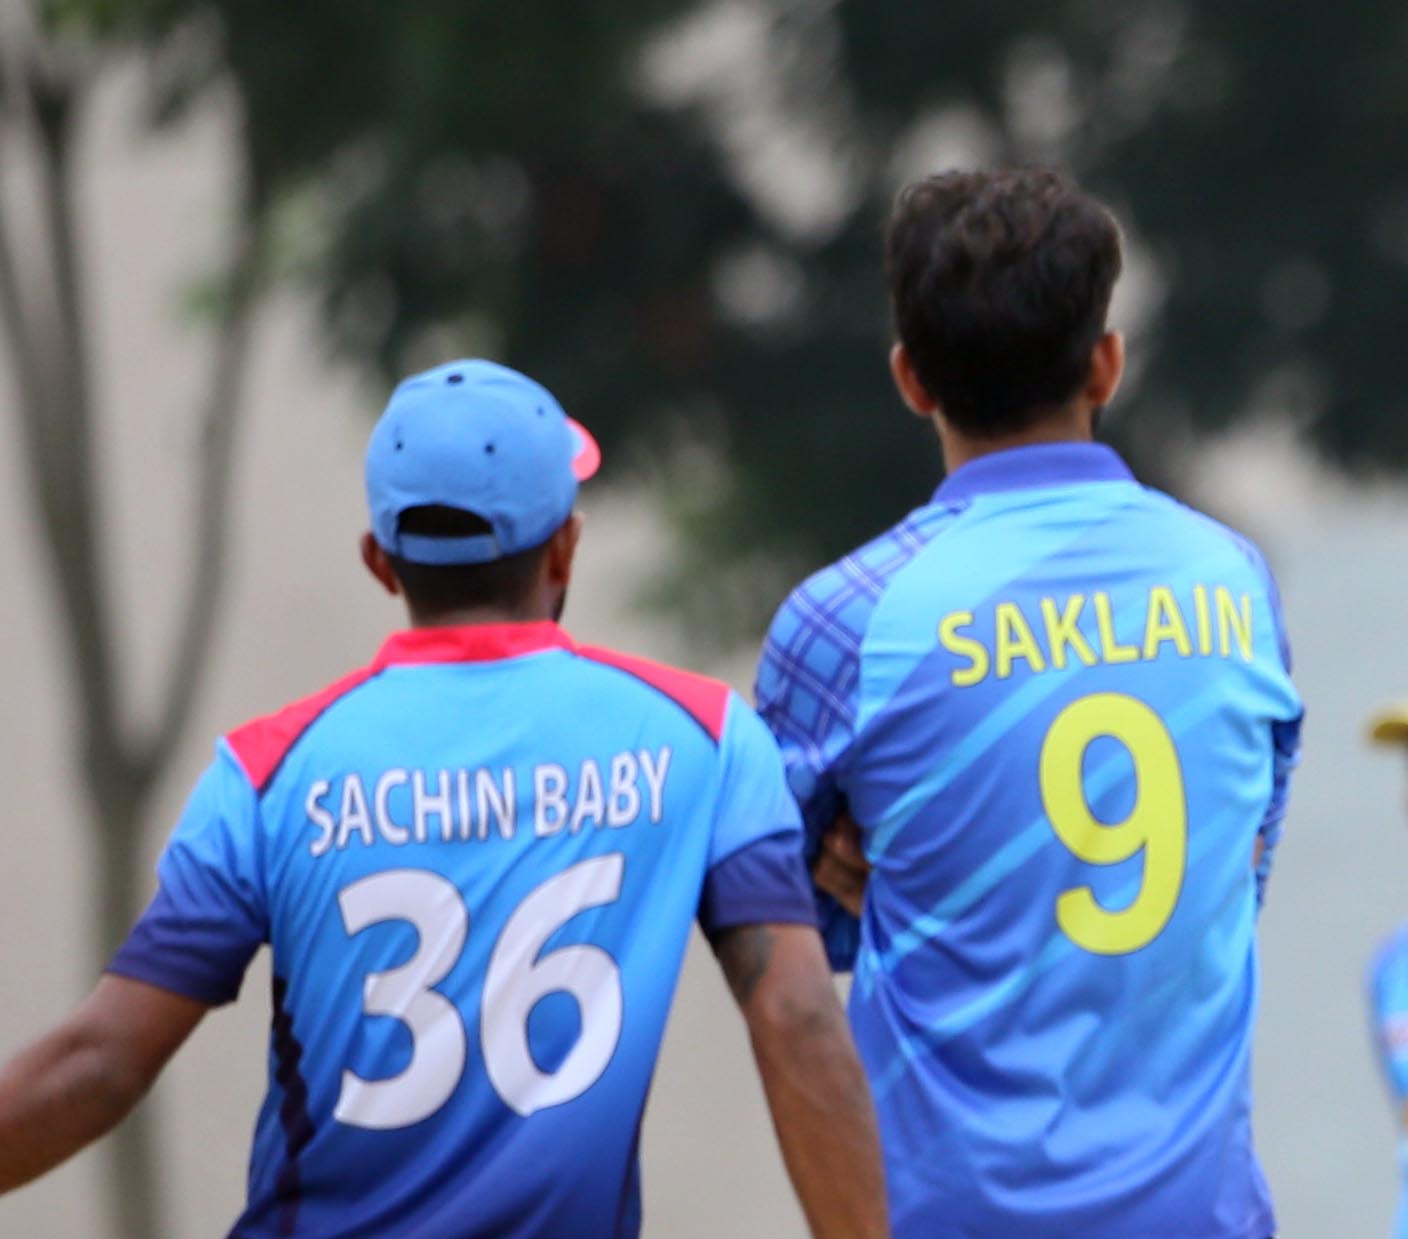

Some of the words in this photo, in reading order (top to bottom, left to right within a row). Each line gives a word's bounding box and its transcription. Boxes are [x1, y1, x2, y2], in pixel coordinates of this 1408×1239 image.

[938, 584, 1255, 687] SAKLAIN
[305, 766, 516, 857] SACHIN
[532, 745, 672, 838] BABY
[1039, 692, 1187, 955] 9
[333, 853, 625, 1130] 36
